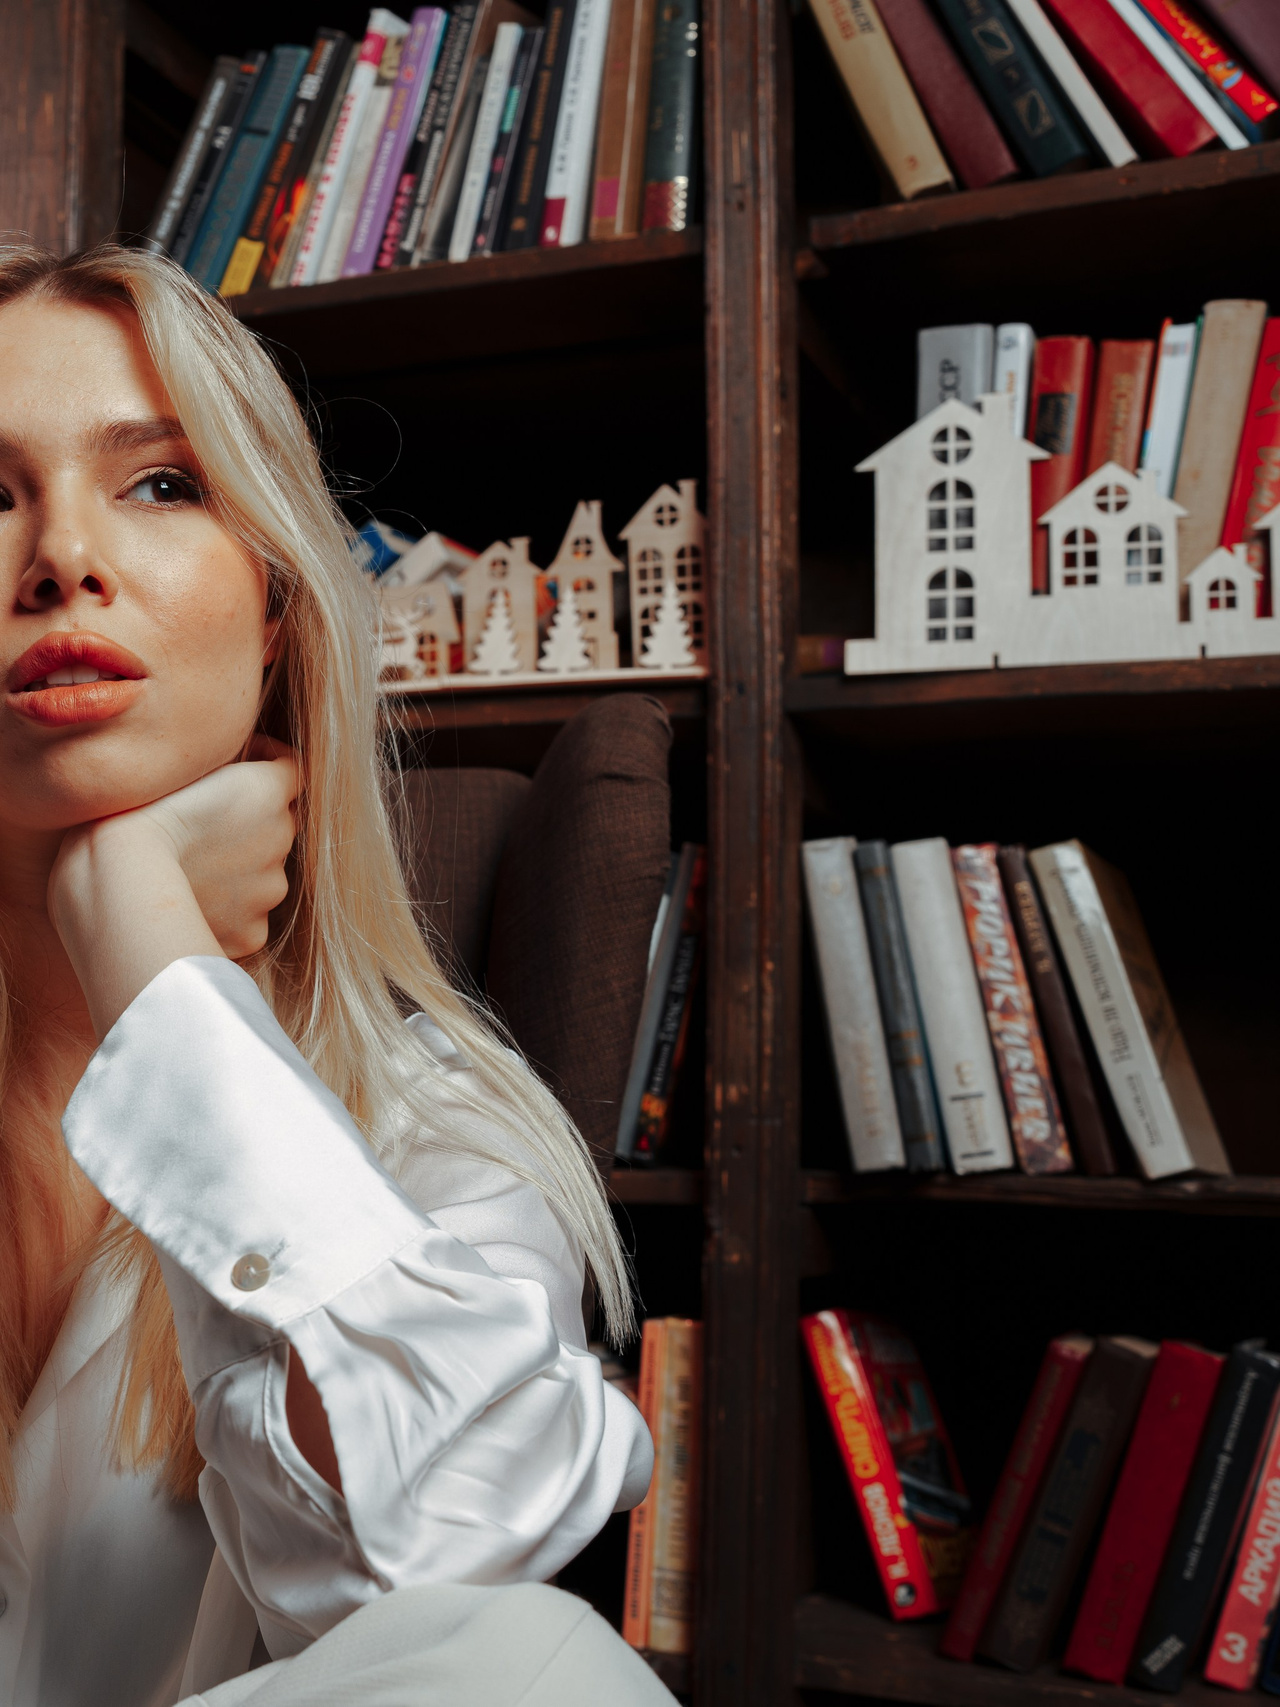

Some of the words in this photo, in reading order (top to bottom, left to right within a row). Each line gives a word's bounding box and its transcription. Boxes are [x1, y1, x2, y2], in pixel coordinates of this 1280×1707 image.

[295, 71, 323, 103] 101
[965, 874, 1025, 1017] РЮРИК
[996, 1016, 1053, 1145] ИВНЕВ
[831, 1389, 881, 1481] СМЕРТЬ
